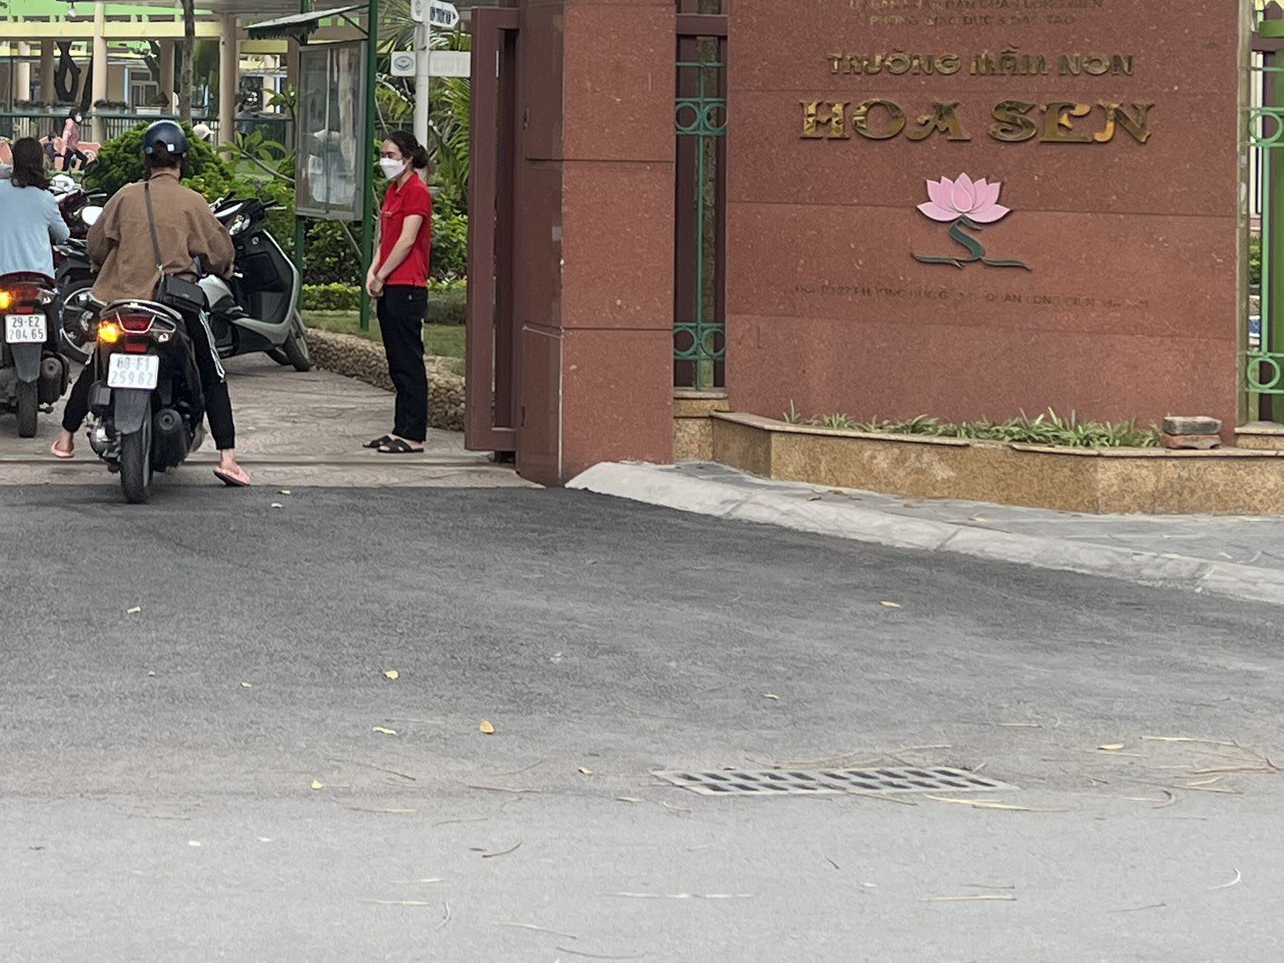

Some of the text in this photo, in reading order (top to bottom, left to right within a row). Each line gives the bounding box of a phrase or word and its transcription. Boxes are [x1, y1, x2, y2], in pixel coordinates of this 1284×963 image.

[827, 47, 963, 76] TRƯỜNG
[1057, 52, 1135, 76] NON
[799, 98, 1156, 145] HOA SEN
[11, 315, 40, 328] 29-E2
